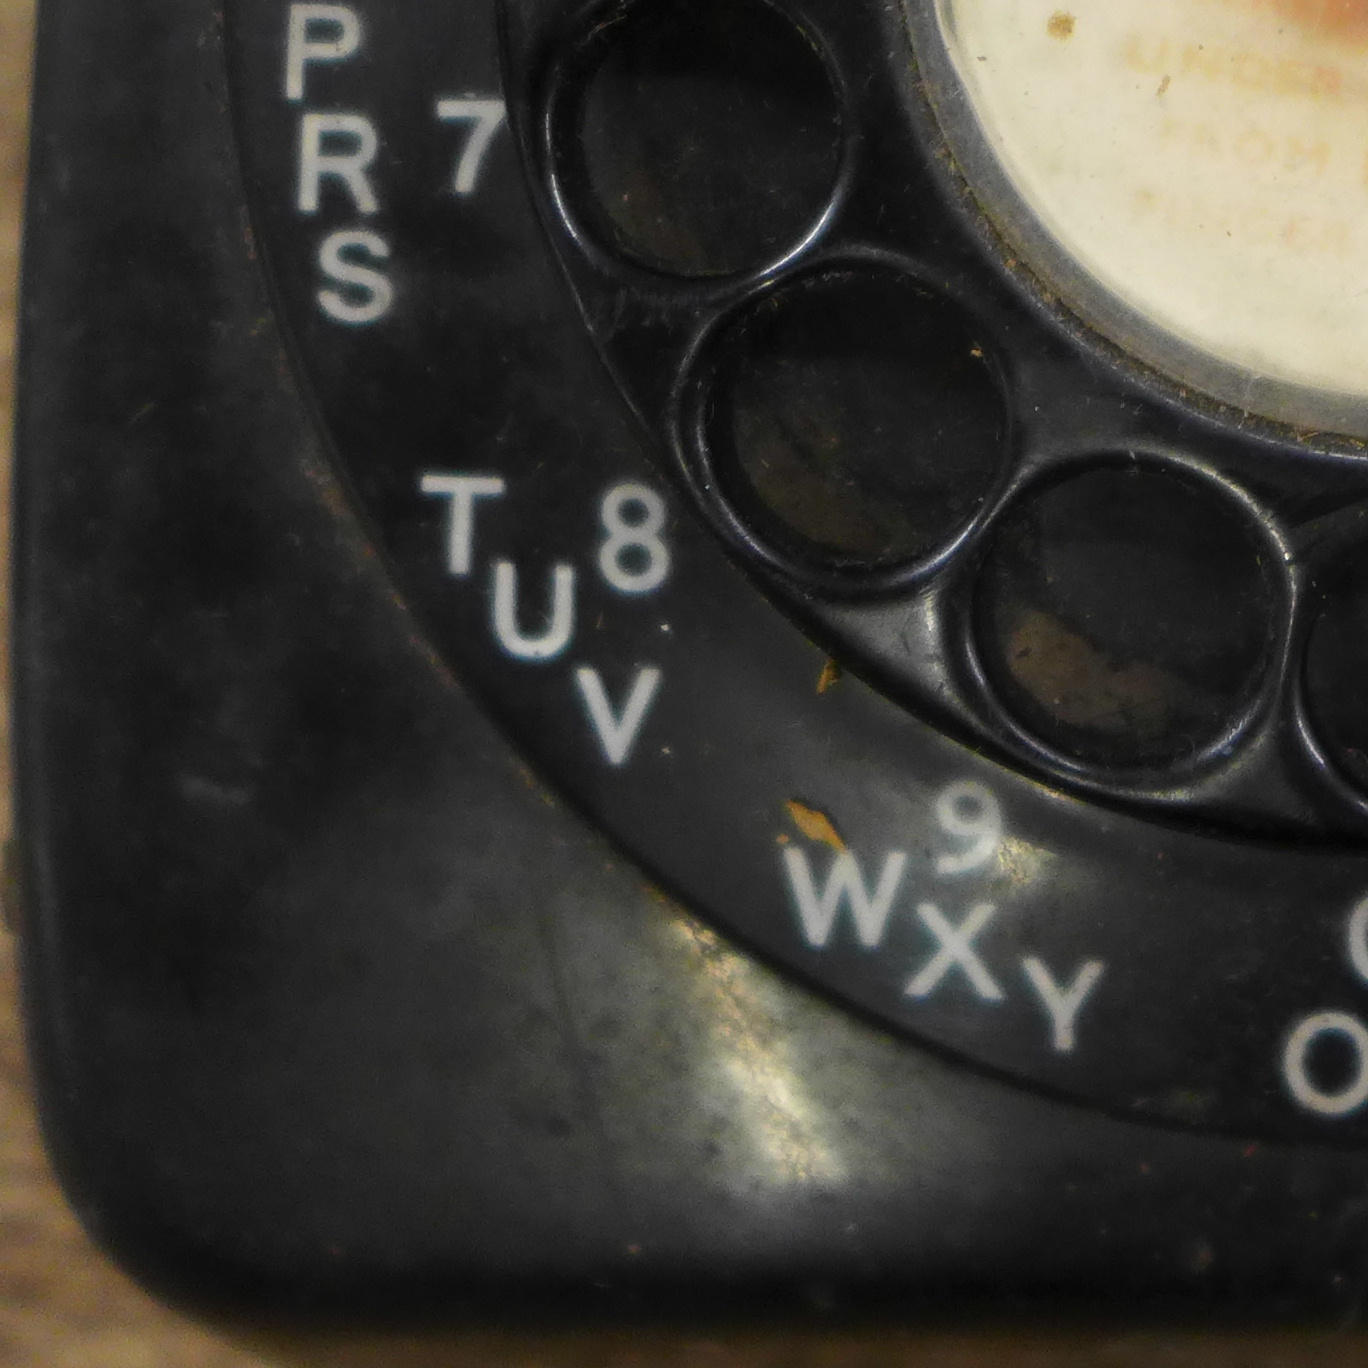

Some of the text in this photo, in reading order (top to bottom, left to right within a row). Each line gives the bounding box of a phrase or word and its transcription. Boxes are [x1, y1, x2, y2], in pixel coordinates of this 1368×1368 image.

[435, 96, 508, 196] 7
[597, 482, 671, 596] 8
[933, 782, 1010, 880] 9
[782, 845, 1107, 1052] WXY
